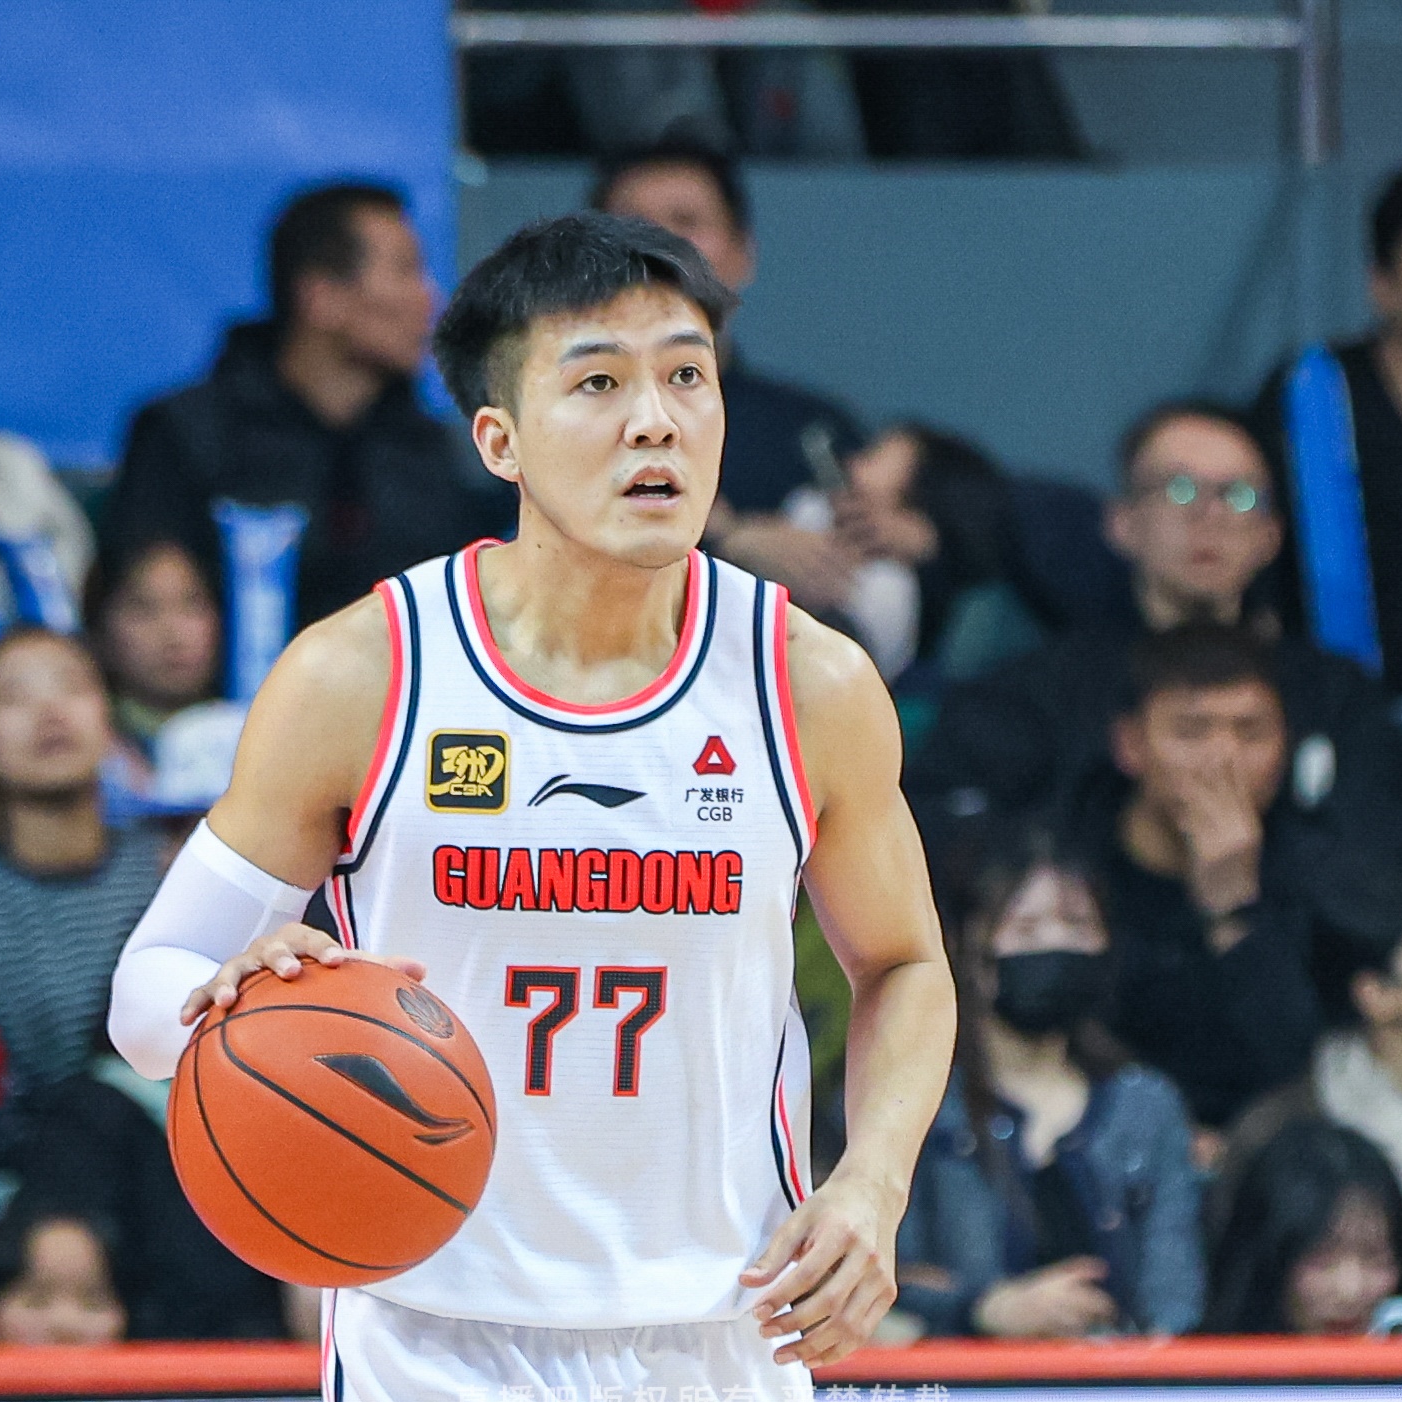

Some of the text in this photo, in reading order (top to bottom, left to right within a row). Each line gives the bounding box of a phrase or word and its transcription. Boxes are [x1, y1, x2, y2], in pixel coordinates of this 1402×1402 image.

[449, 783, 494, 797] CBA
[685, 787, 744, 803] 广发银行
[697, 806, 733, 821] CGB
[433, 845, 742, 915] GUANGDONG
[504, 965, 668, 1097] 77
